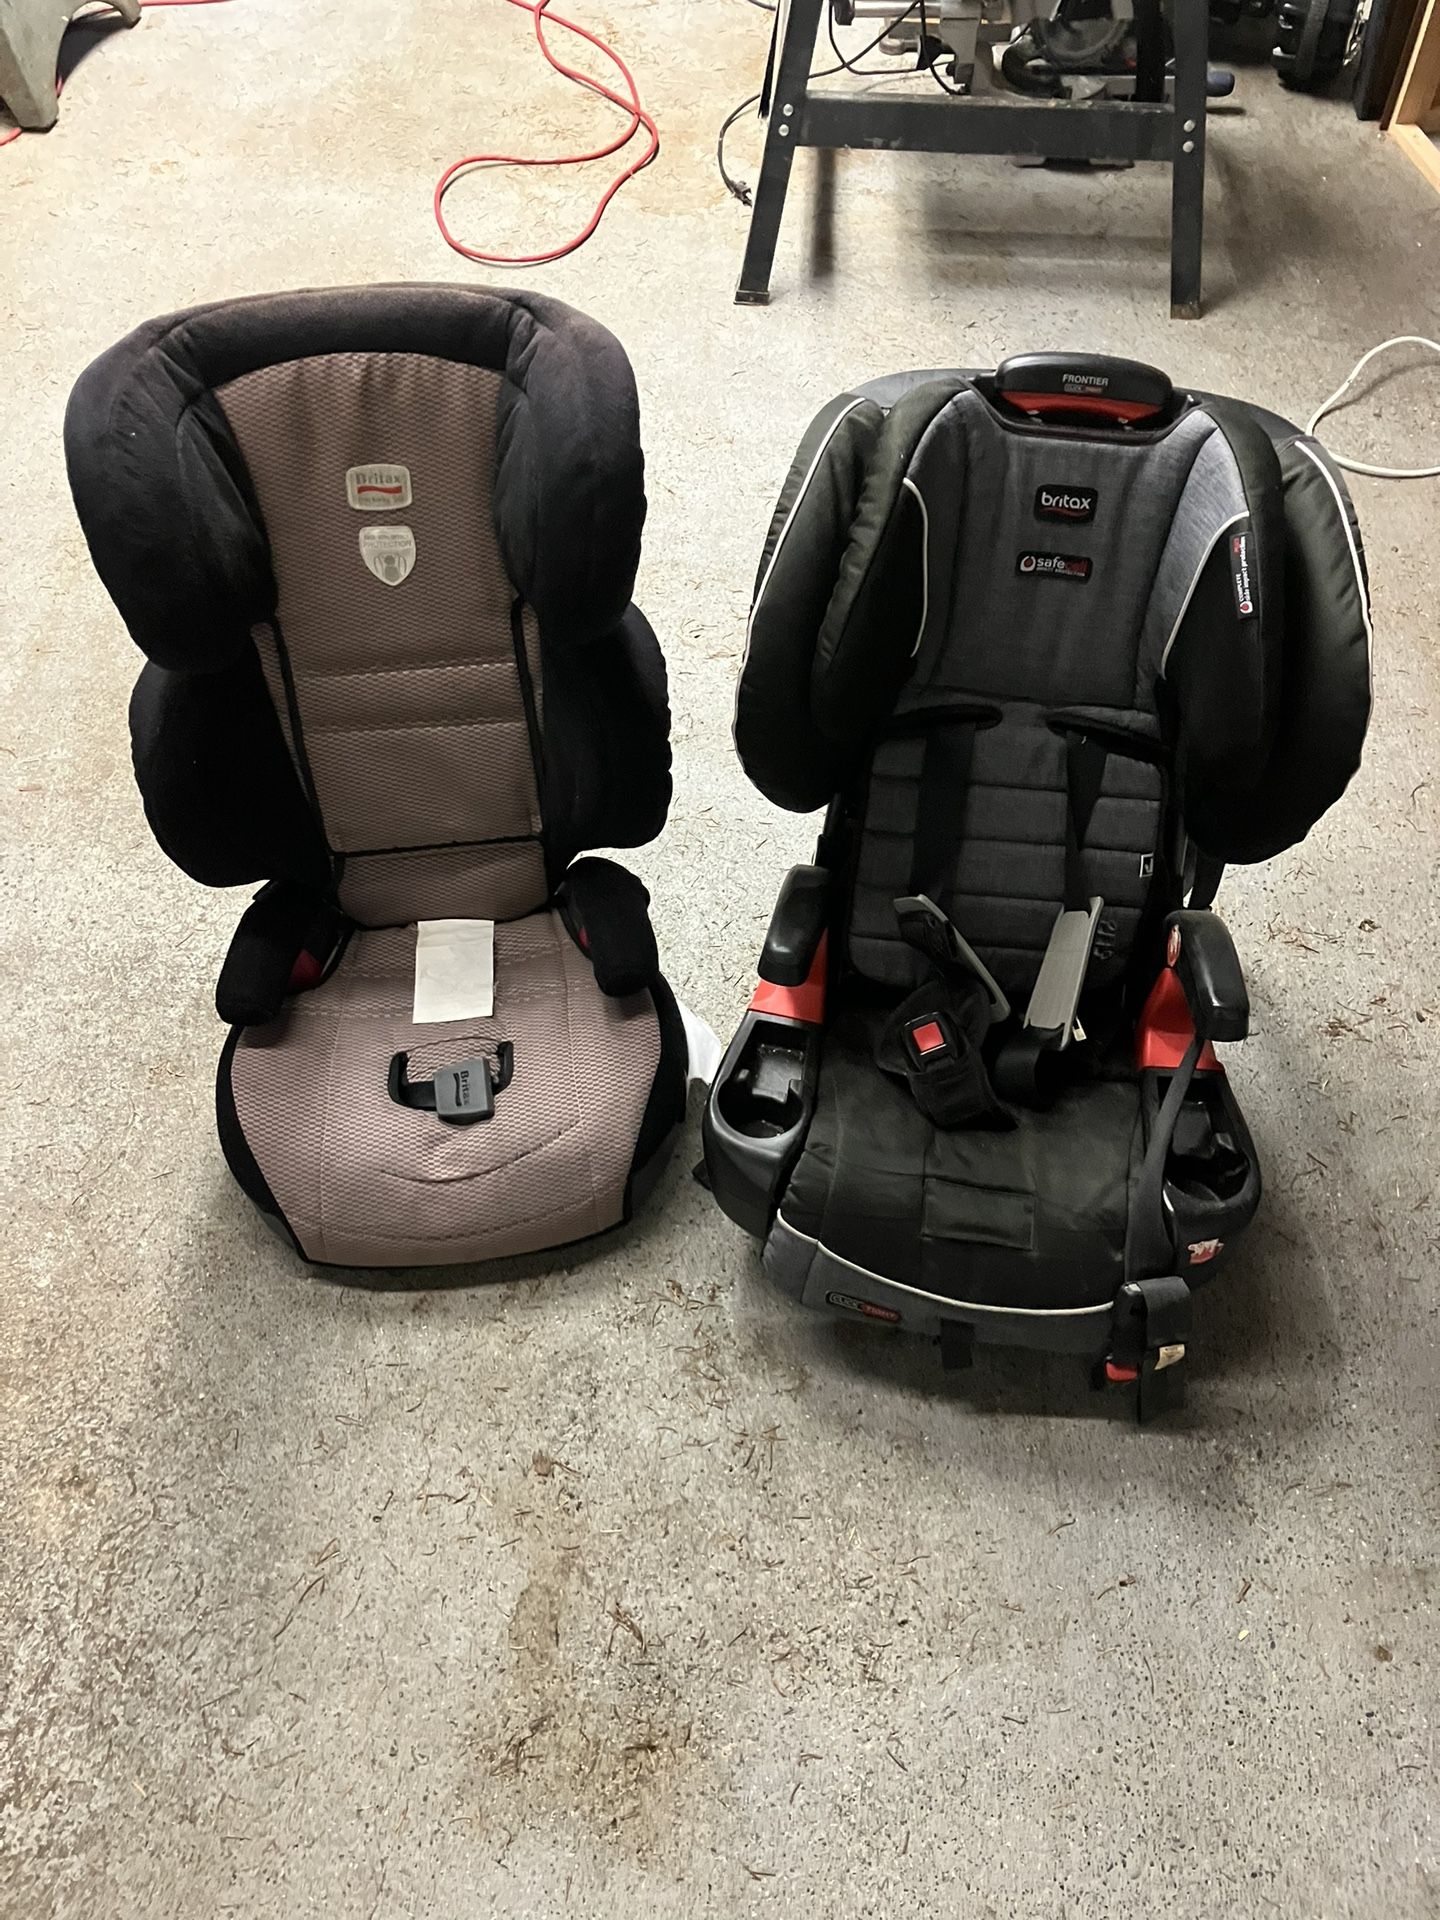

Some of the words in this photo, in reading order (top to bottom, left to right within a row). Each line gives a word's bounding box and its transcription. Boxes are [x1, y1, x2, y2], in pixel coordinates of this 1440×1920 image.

[1062, 374, 1109, 386] FRONTIER
[1041, 491, 1092, 510] britax
[1239, 536, 1249, 567] protection
[1241, 568, 1250, 588] impact
[460, 1070, 470, 1106] Britax
